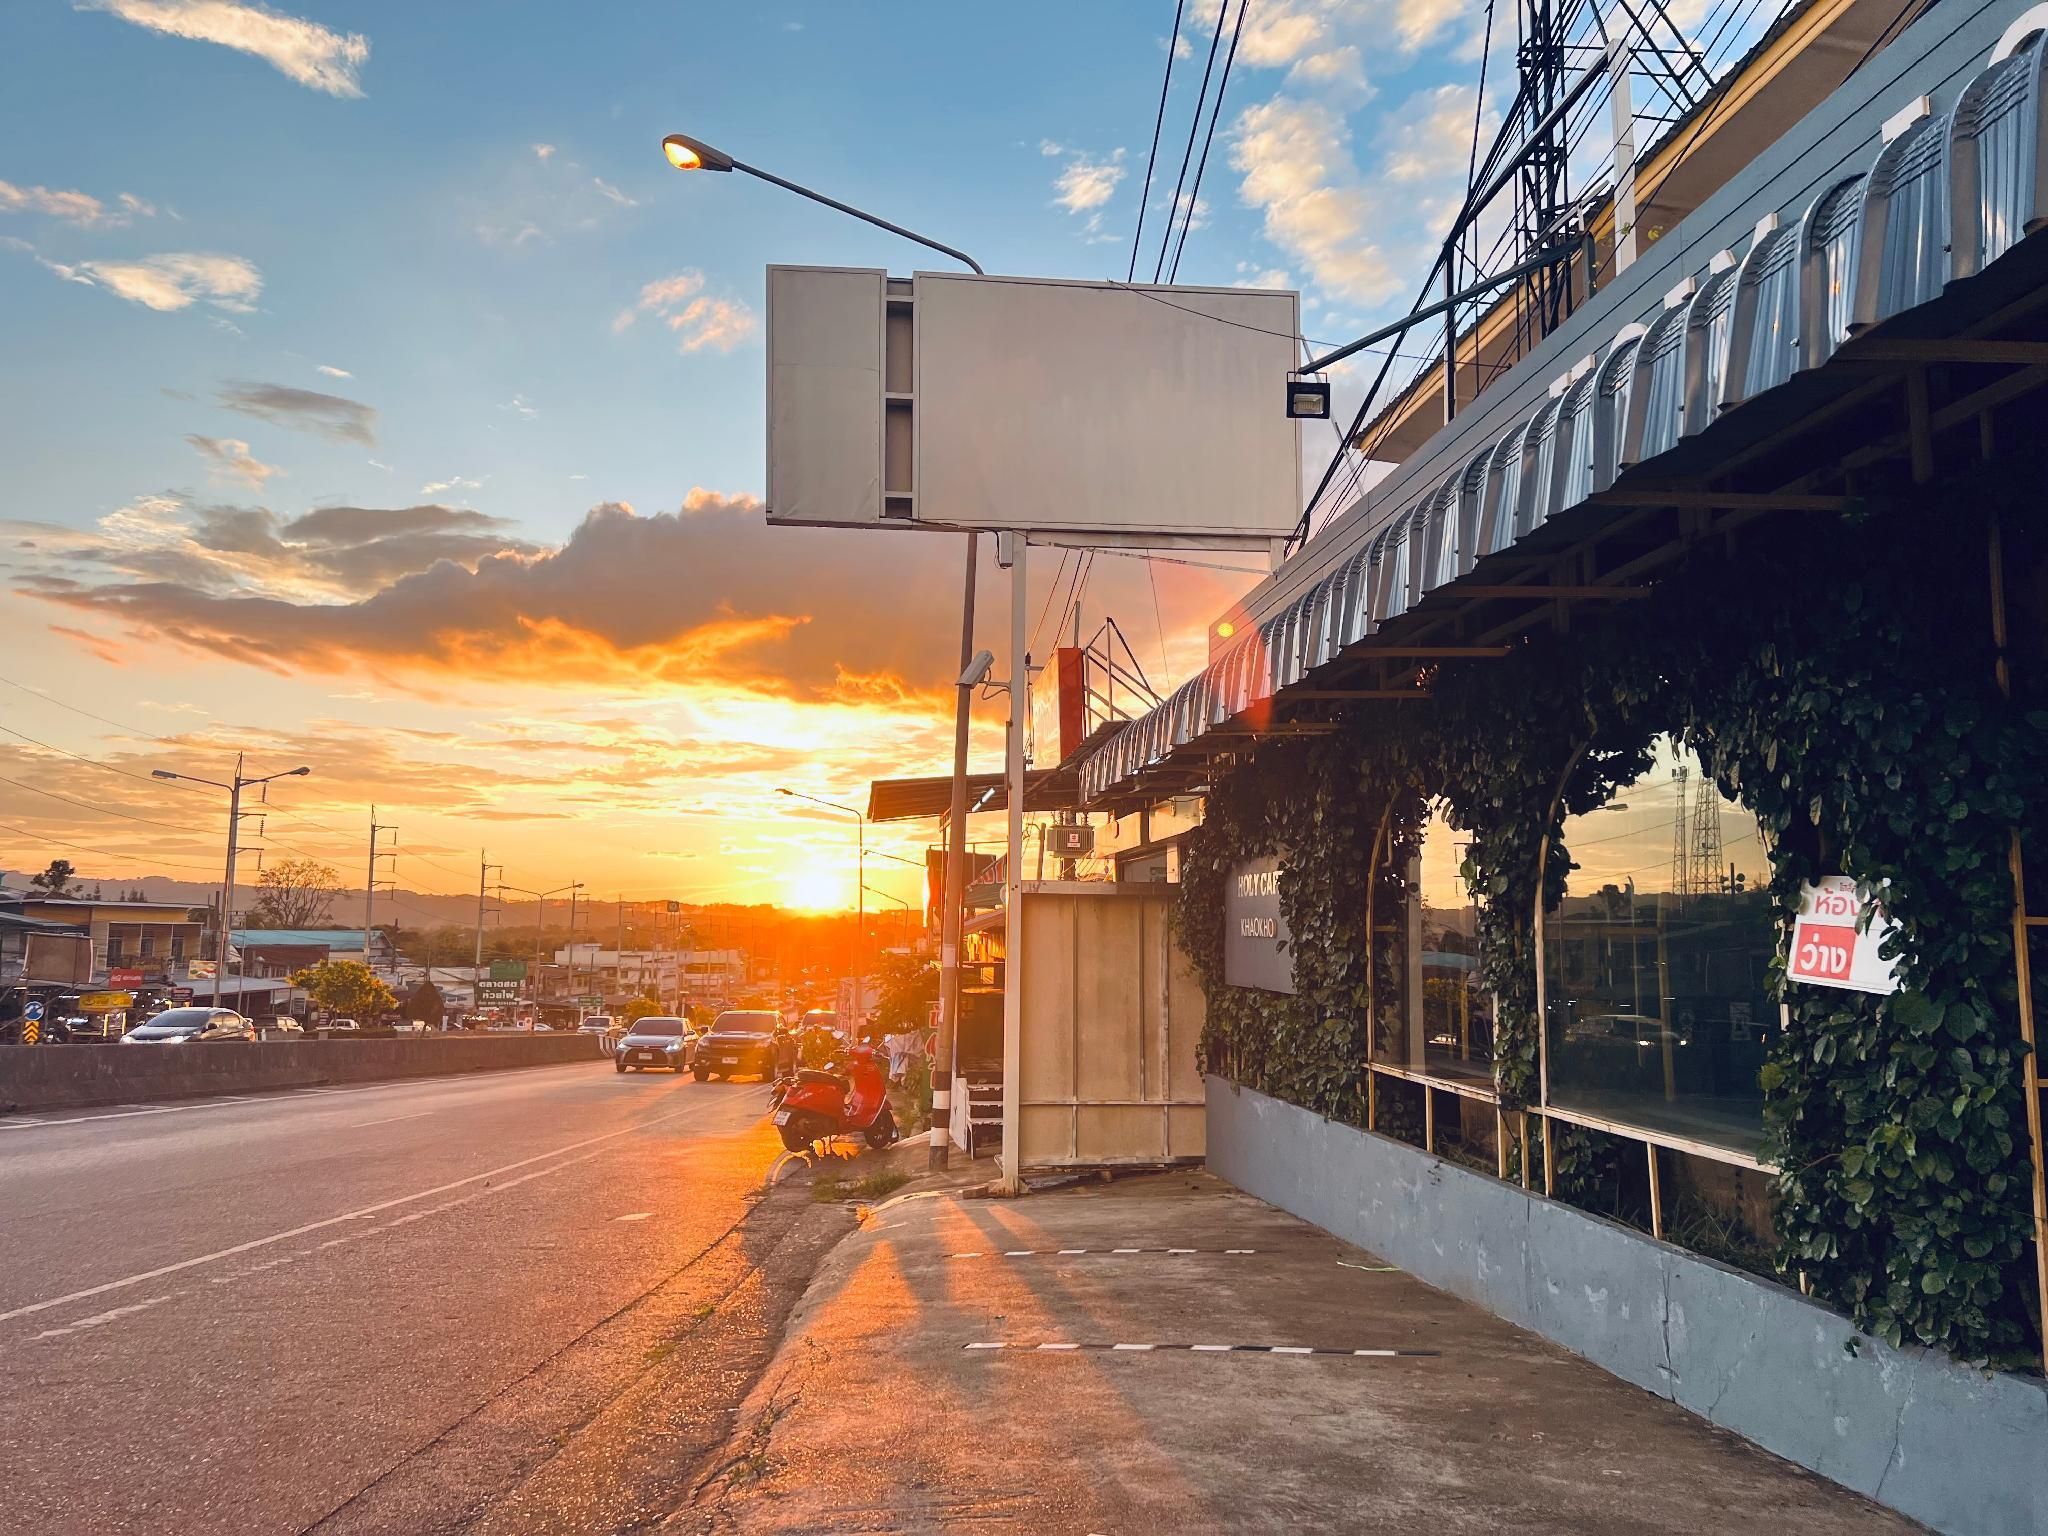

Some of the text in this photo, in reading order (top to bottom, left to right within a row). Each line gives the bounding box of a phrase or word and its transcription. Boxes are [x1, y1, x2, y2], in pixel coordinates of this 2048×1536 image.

[1238, 873, 1259, 897] HOLY
[1240, 917, 1275, 938] KHAOKHO
[1800, 933, 1847, 974] ว่าง
